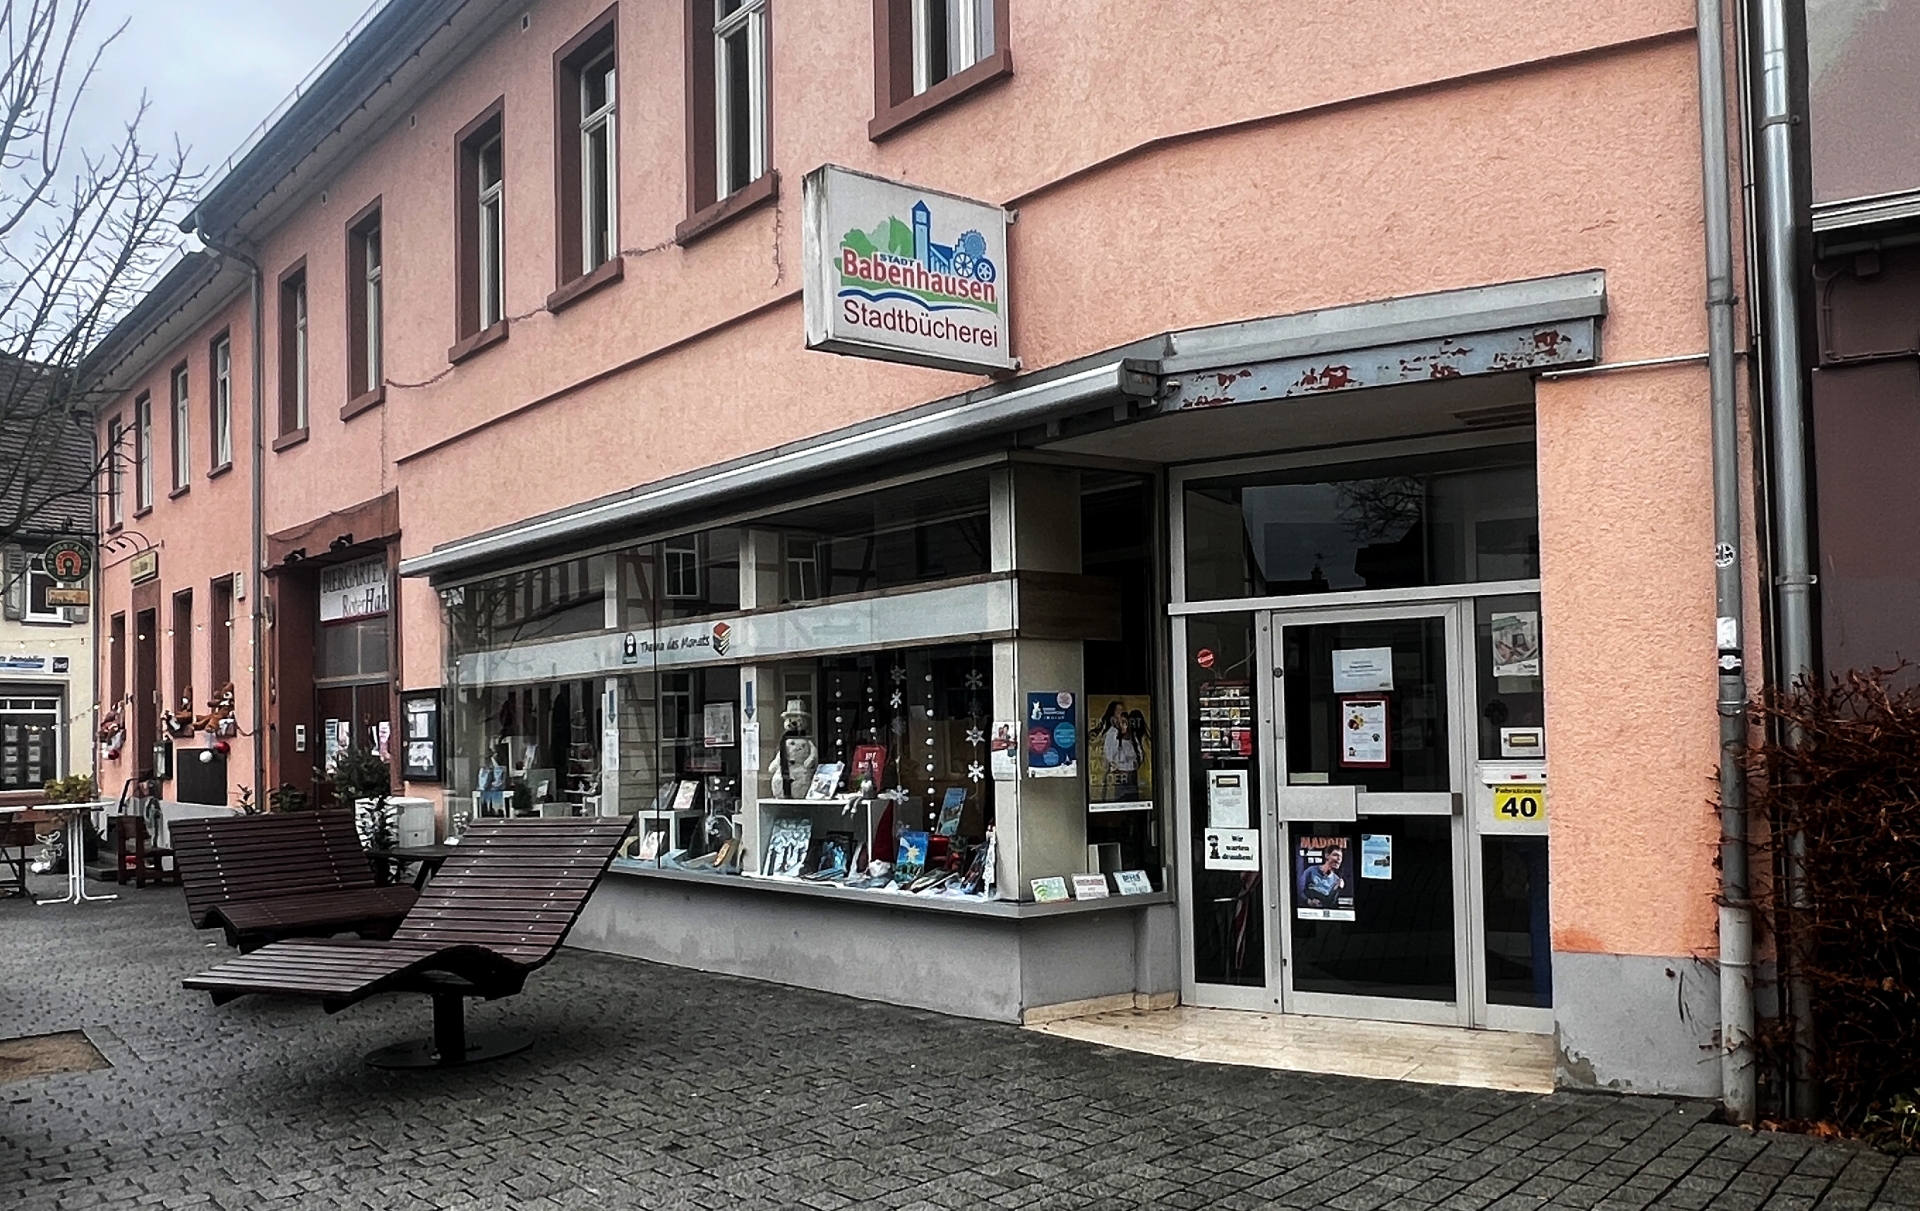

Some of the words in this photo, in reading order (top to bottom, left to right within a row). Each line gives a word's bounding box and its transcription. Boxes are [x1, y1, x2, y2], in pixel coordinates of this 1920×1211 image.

[879, 253, 915, 266] STADT
[843, 248, 995, 303] Babenhausen
[844, 300, 998, 347] Stadtbücherei
[365, 585, 387, 614] Hah
[1502, 797, 1537, 817] 40
